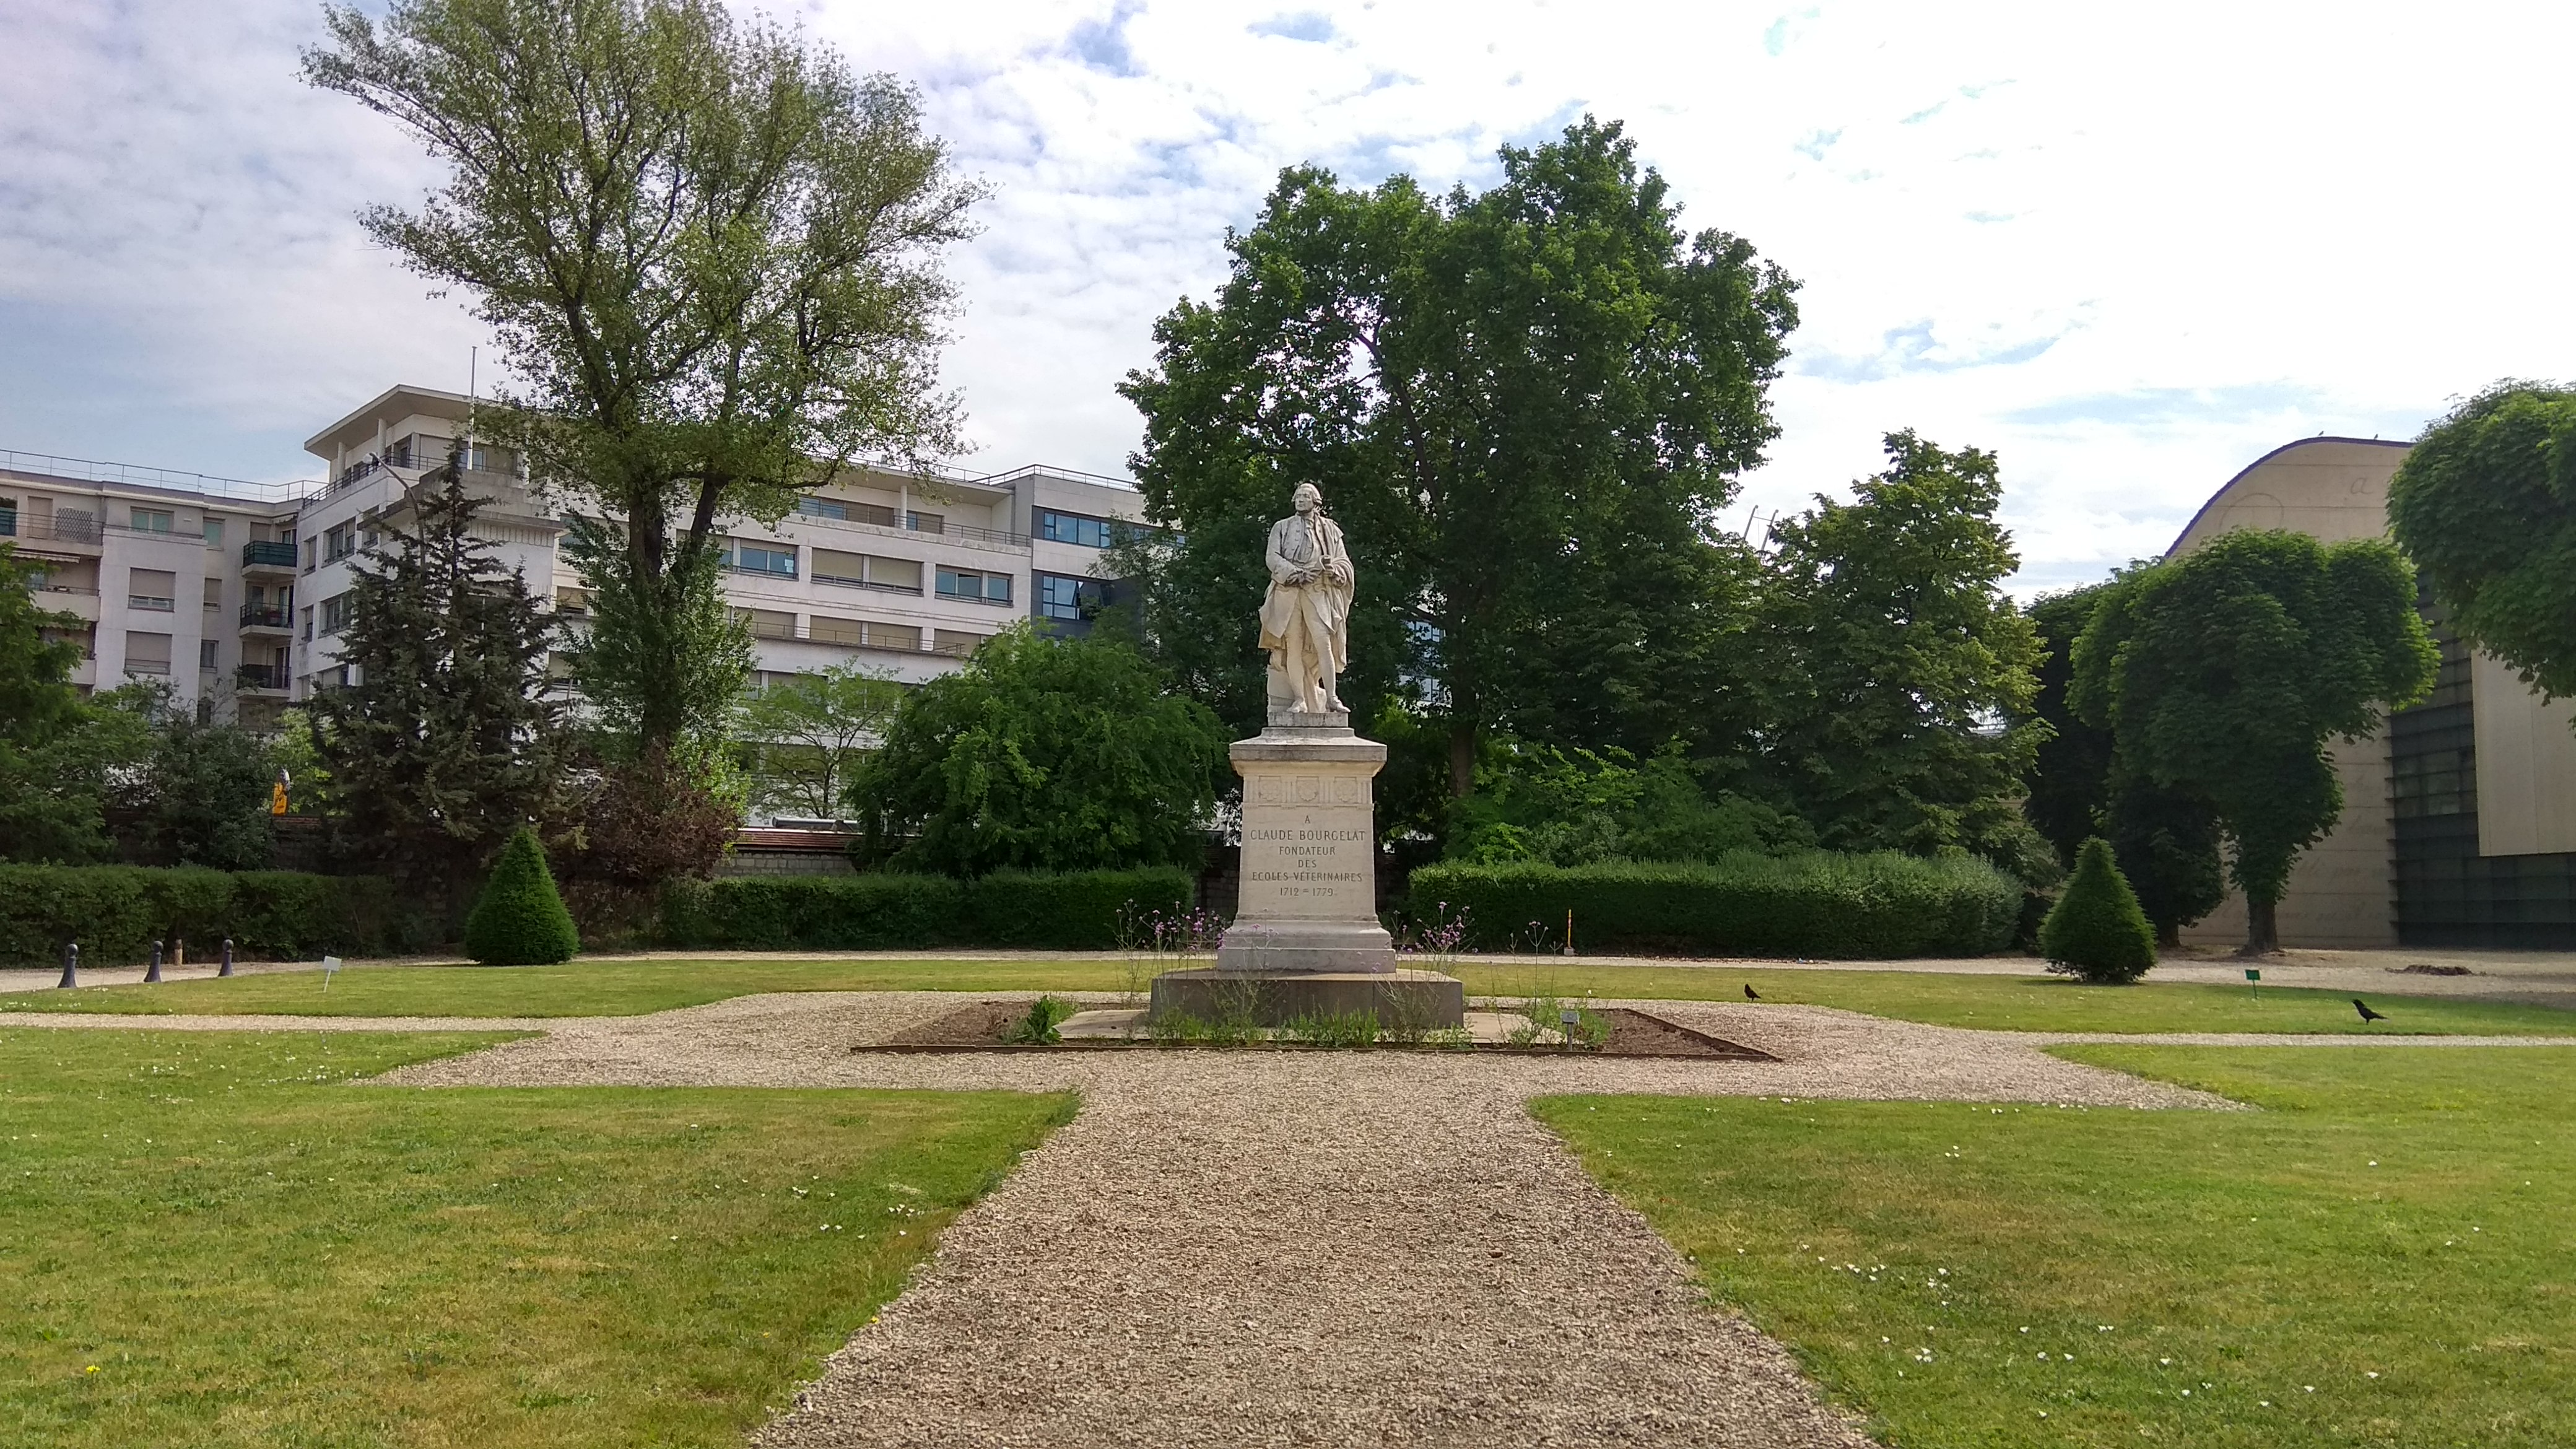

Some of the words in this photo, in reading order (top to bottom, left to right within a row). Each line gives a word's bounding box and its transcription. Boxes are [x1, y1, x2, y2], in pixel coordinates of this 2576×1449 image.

[1304, 814, 1311, 824] A
[1250, 829, 1294, 841] CLAUDE
[1299, 830, 1366, 842] BOURGELAT
[1279, 846, 1336, 856] FONDATEUR
[1298, 859, 1317, 868] DES
[1251, 871, 1289, 881] ECOLES
[1280, 887, 1299, 897] 1712
[1313, 888, 1333, 897] 1779
